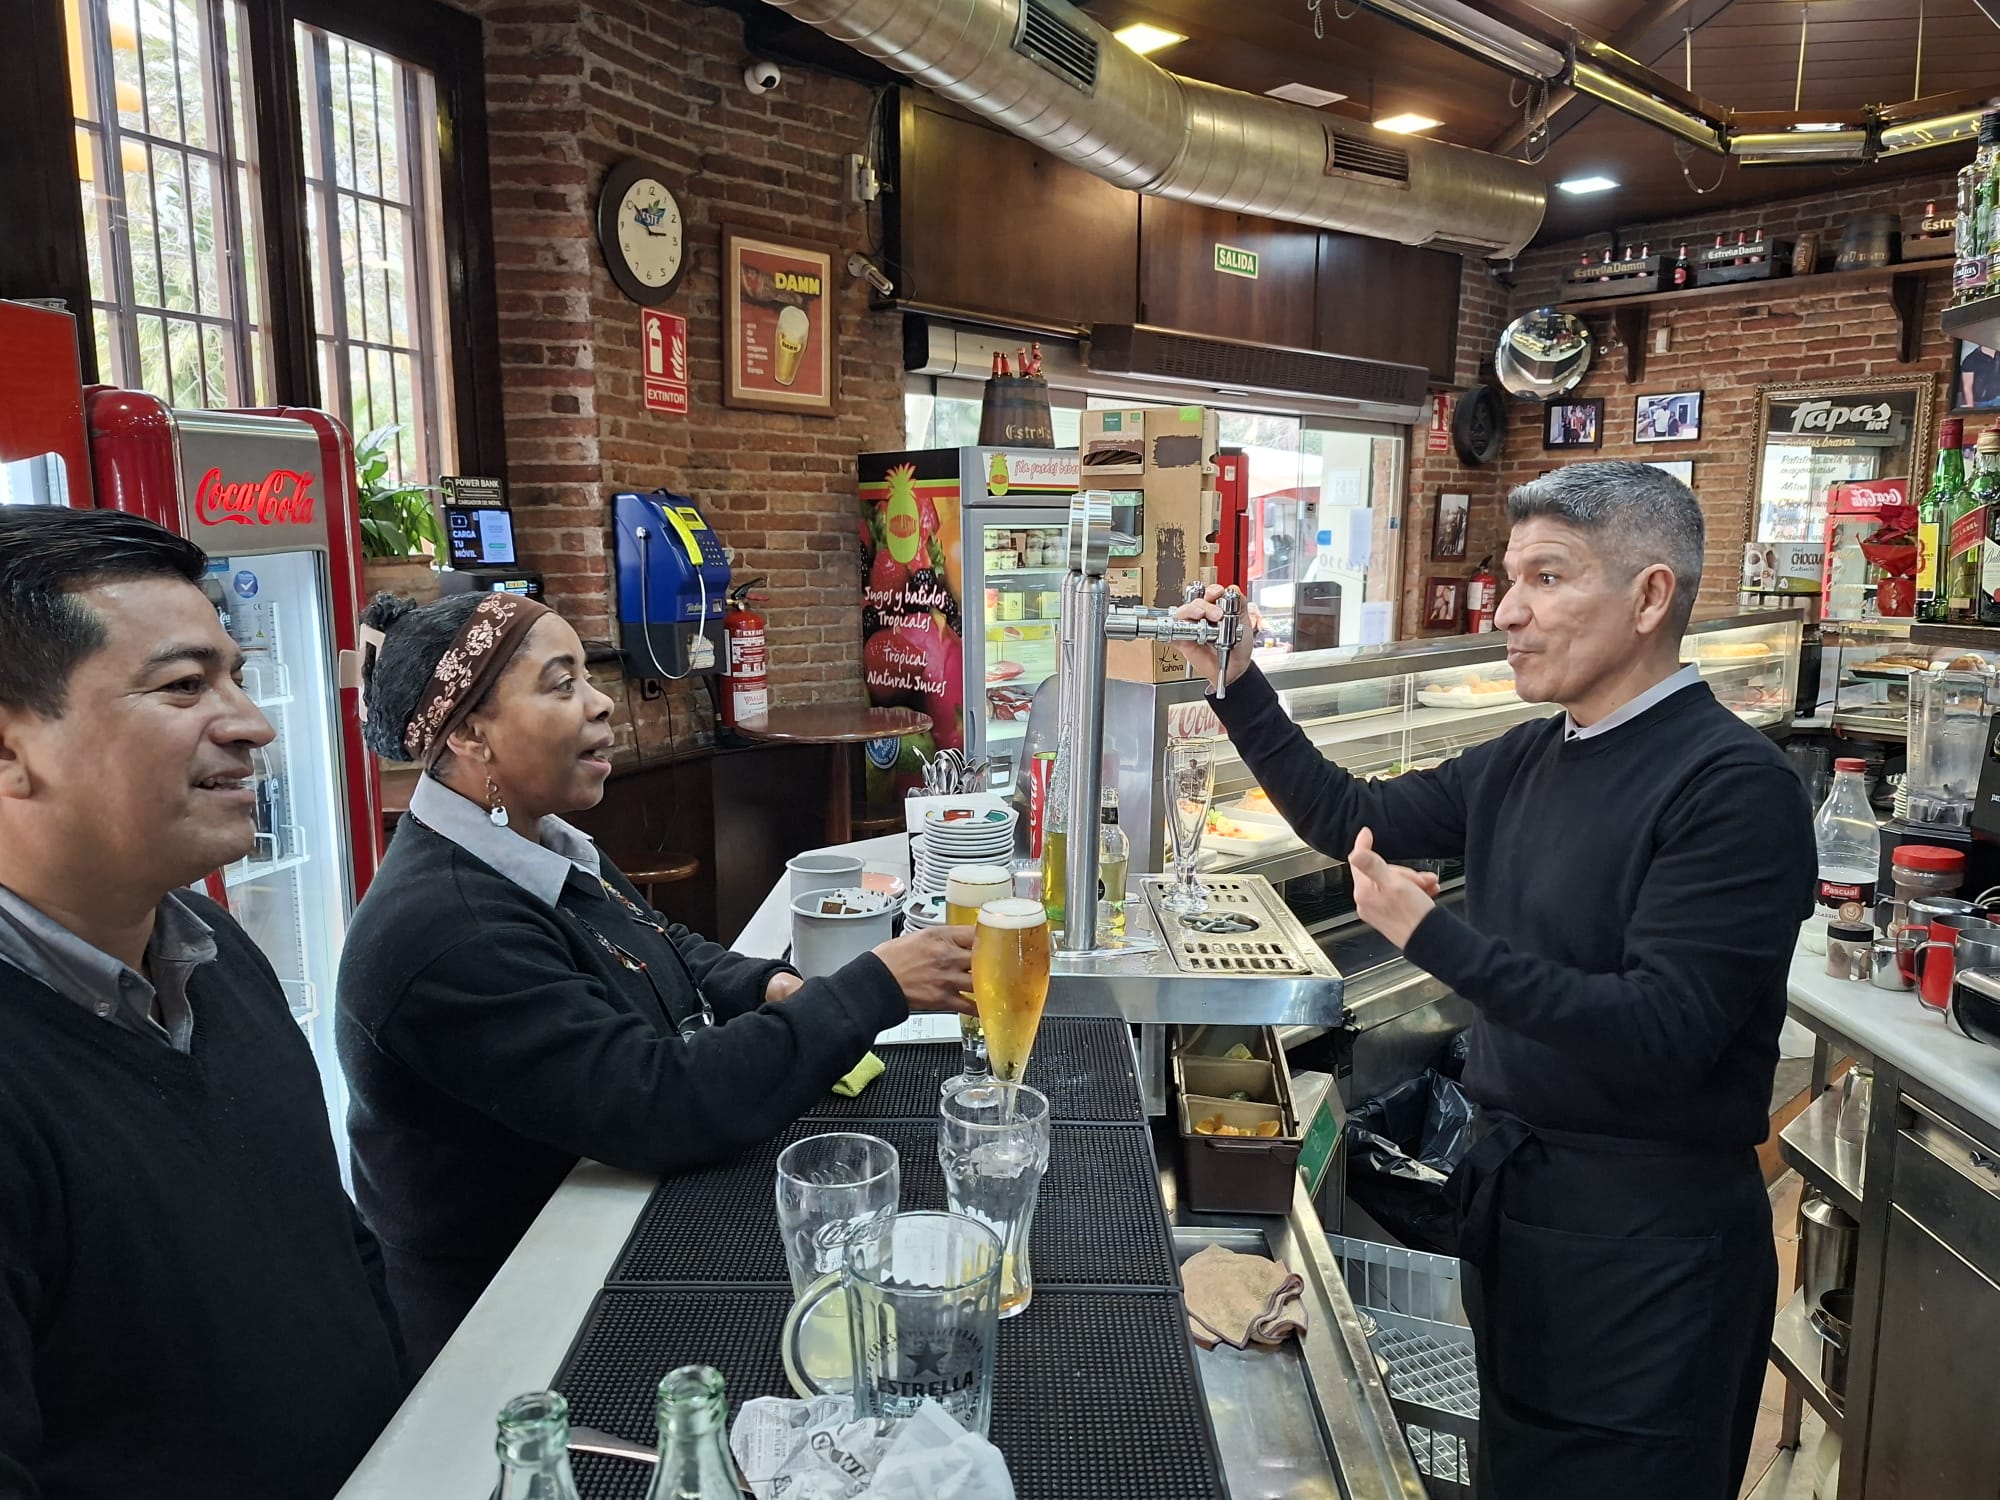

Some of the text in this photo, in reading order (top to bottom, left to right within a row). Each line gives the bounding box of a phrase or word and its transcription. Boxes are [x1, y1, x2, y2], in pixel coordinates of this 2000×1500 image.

[1219, 249, 1254, 273] SALIDA
[1707, 246, 1764, 260] Estrella Damm
[1573, 261, 1646, 279] Estrella Damm
[775, 272, 821, 295] DAMM
[647, 388, 685, 405] EXTINTOR
[1790, 400, 1892, 436] Tapas
[1821, 435, 1857, 448] bravas
[1029, 456, 1058, 481] puedes
[455, 478, 500, 488] POWER BANK
[194, 466, 316, 527] Coca-Cola
[452, 530, 477, 538] CARGA
[1959, 521, 1979, 536] LABEL
[453, 540, 464, 548] TU
[455, 548, 478, 558] MÓVIL
[864, 582, 947, 612] Jugos y batidos
[877, 608, 932, 635] Tropicales
[883, 646, 928, 673] Tropical
[1162, 662, 1184, 673] kahova
[866, 669, 947, 697] Natural Juices
[1823, 885, 1858, 896] Pascual
[1814, 911, 1839, 920] CLASSIC
[877, 1371, 974, 1397] ESTRELLA
